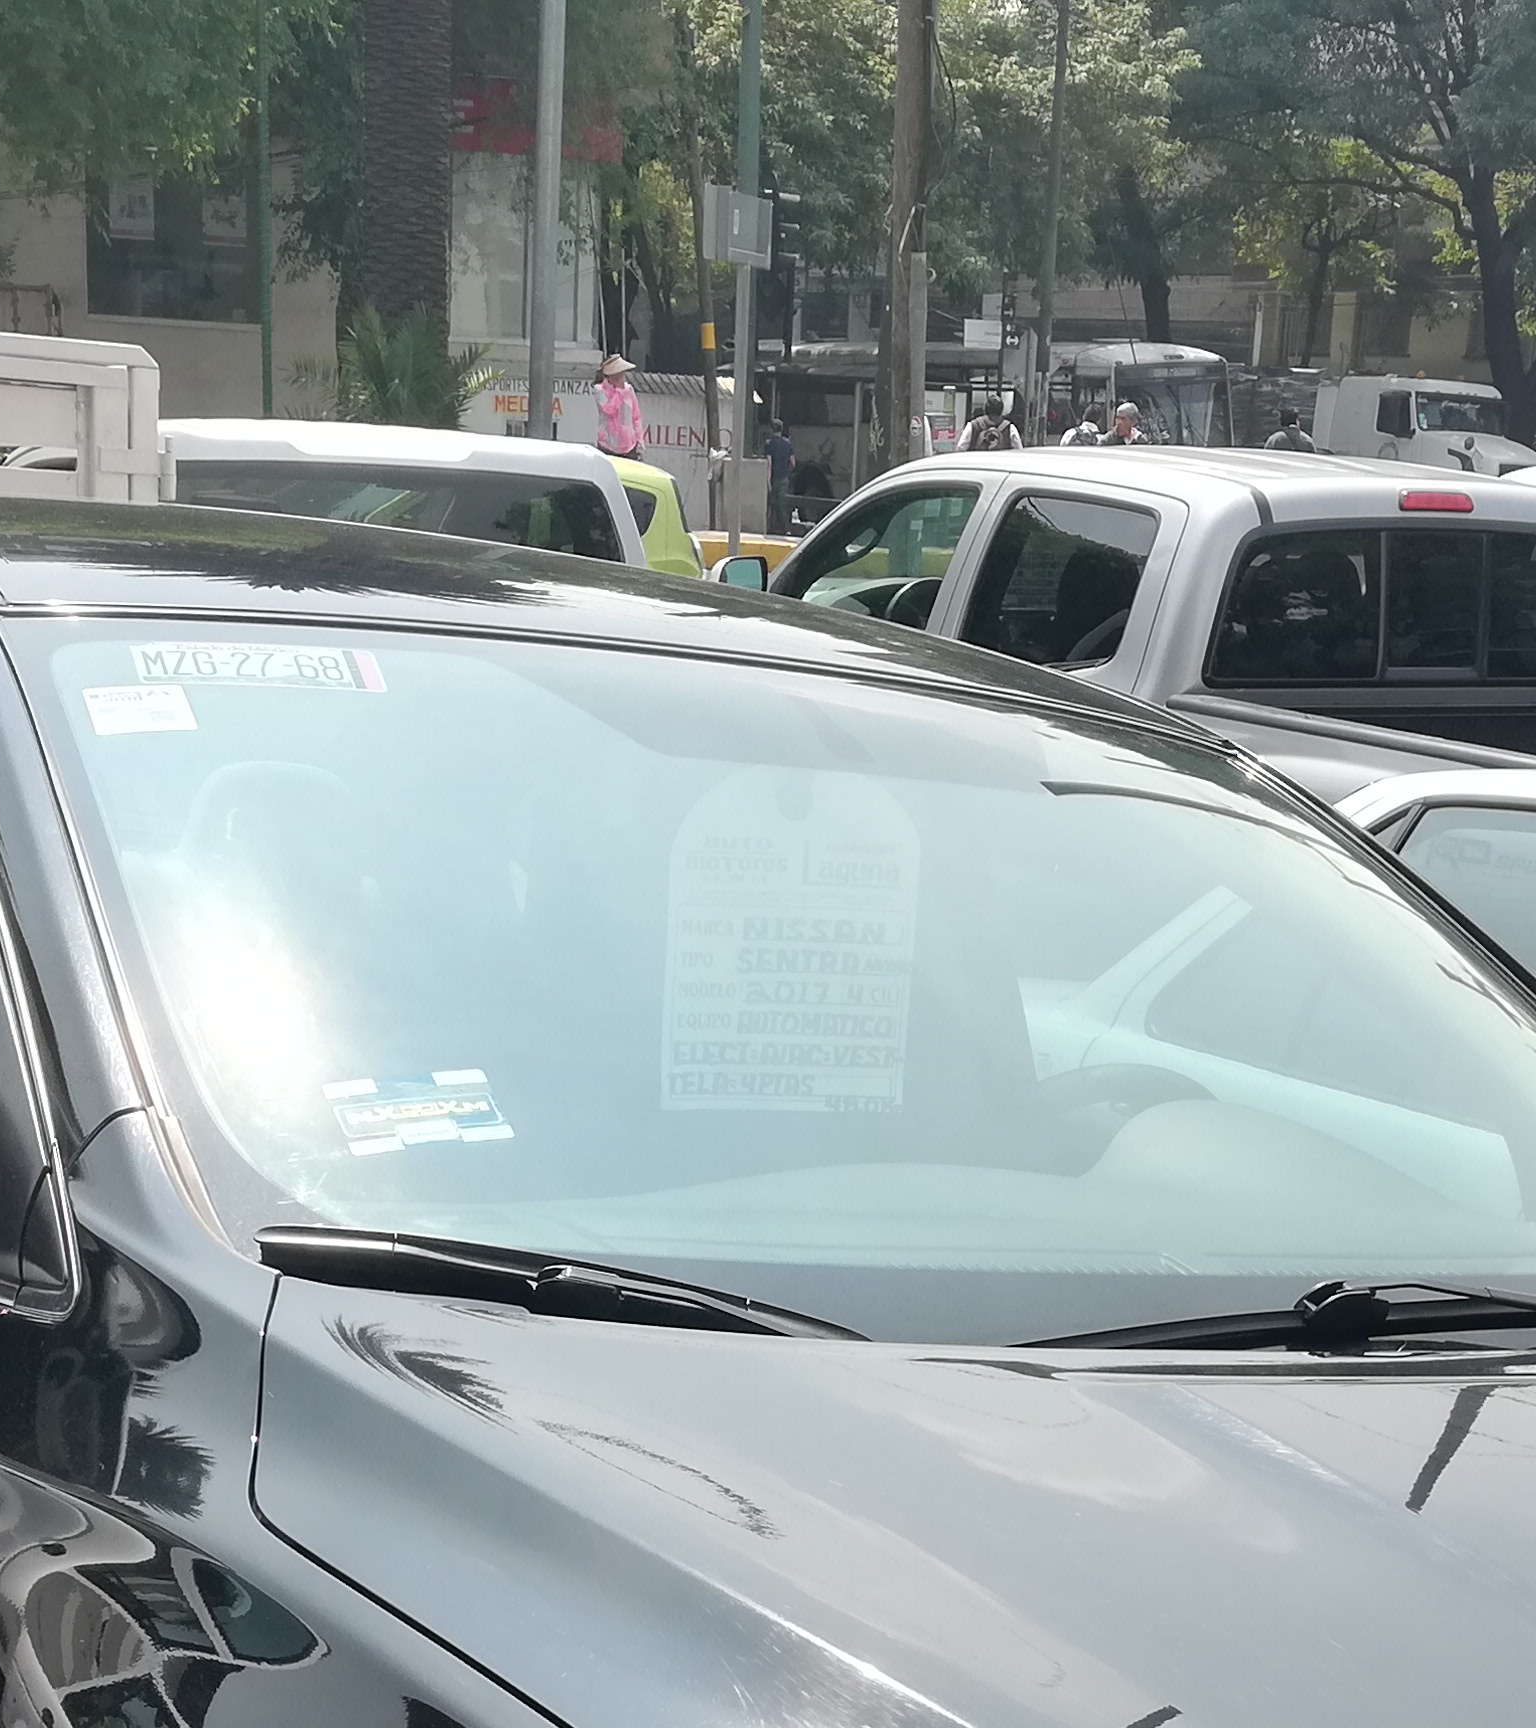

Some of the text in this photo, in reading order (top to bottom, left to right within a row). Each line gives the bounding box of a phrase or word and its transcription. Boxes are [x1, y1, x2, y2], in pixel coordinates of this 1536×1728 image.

[643, 424, 732, 449] MILENO
[141, 650, 344, 681] MZG-27-68
[680, 916, 887, 945] MARCA NISSAN
[680, 950, 714, 968] TIPO
[735, 946, 861, 975] SENTRA
[678, 981, 736, 999] MODELO
[744, 980, 831, 1004] 2017
[677, 1009, 895, 1038] EQUIPO AUTOMATICO
